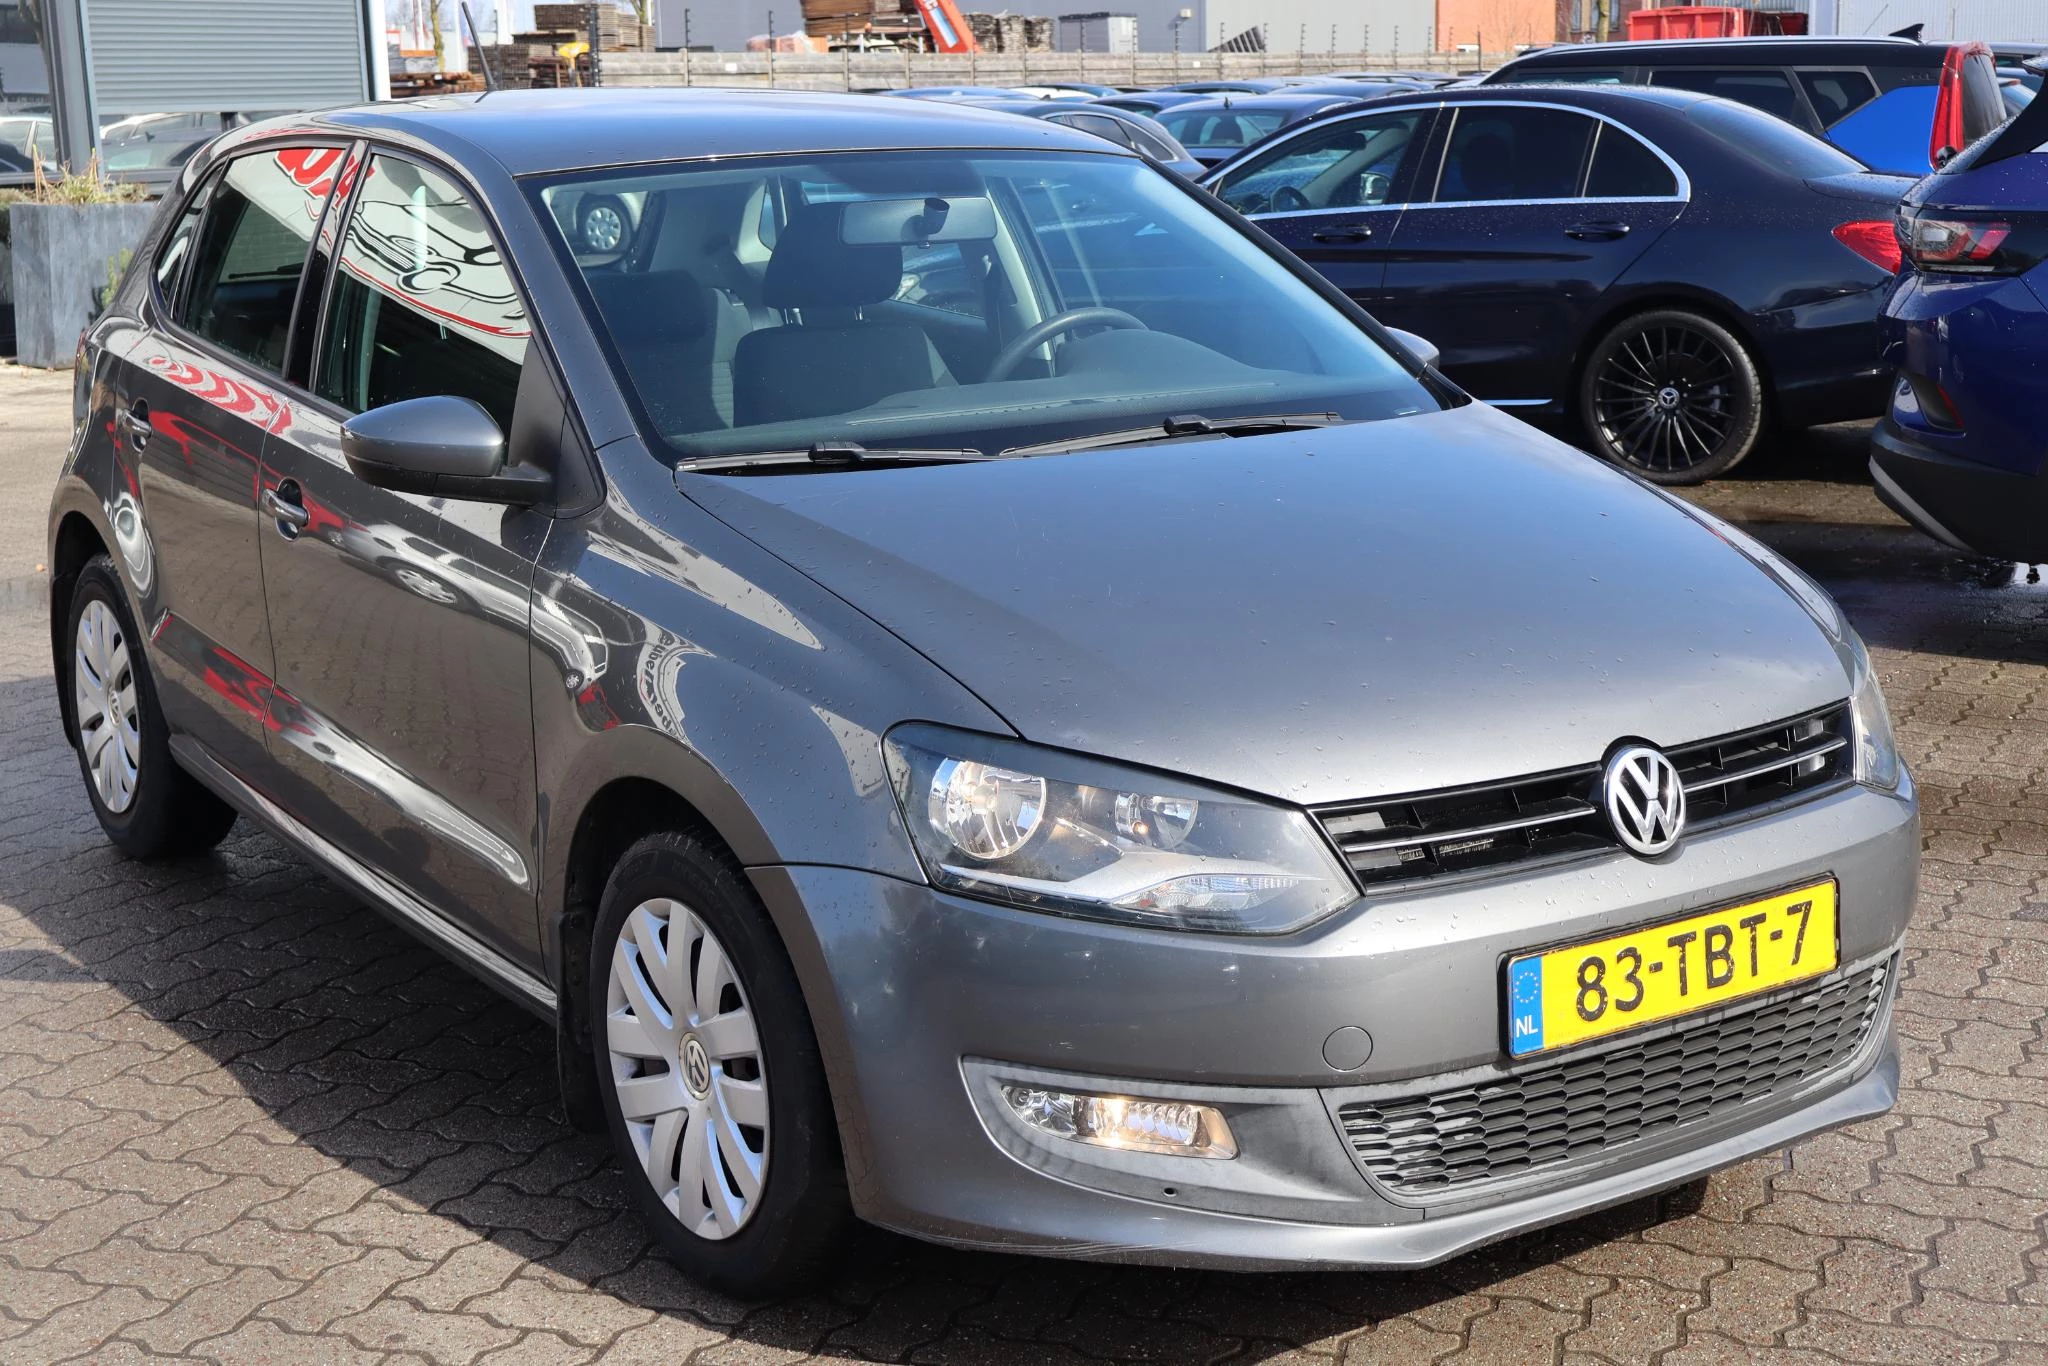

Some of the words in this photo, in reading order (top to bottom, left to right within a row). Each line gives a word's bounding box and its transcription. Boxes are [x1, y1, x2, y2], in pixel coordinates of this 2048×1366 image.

[1605, 747, 1685, 854] VW
[1576, 900, 1813, 1022] 83-TBT-7
[1515, 1015, 1538, 1038] NL
